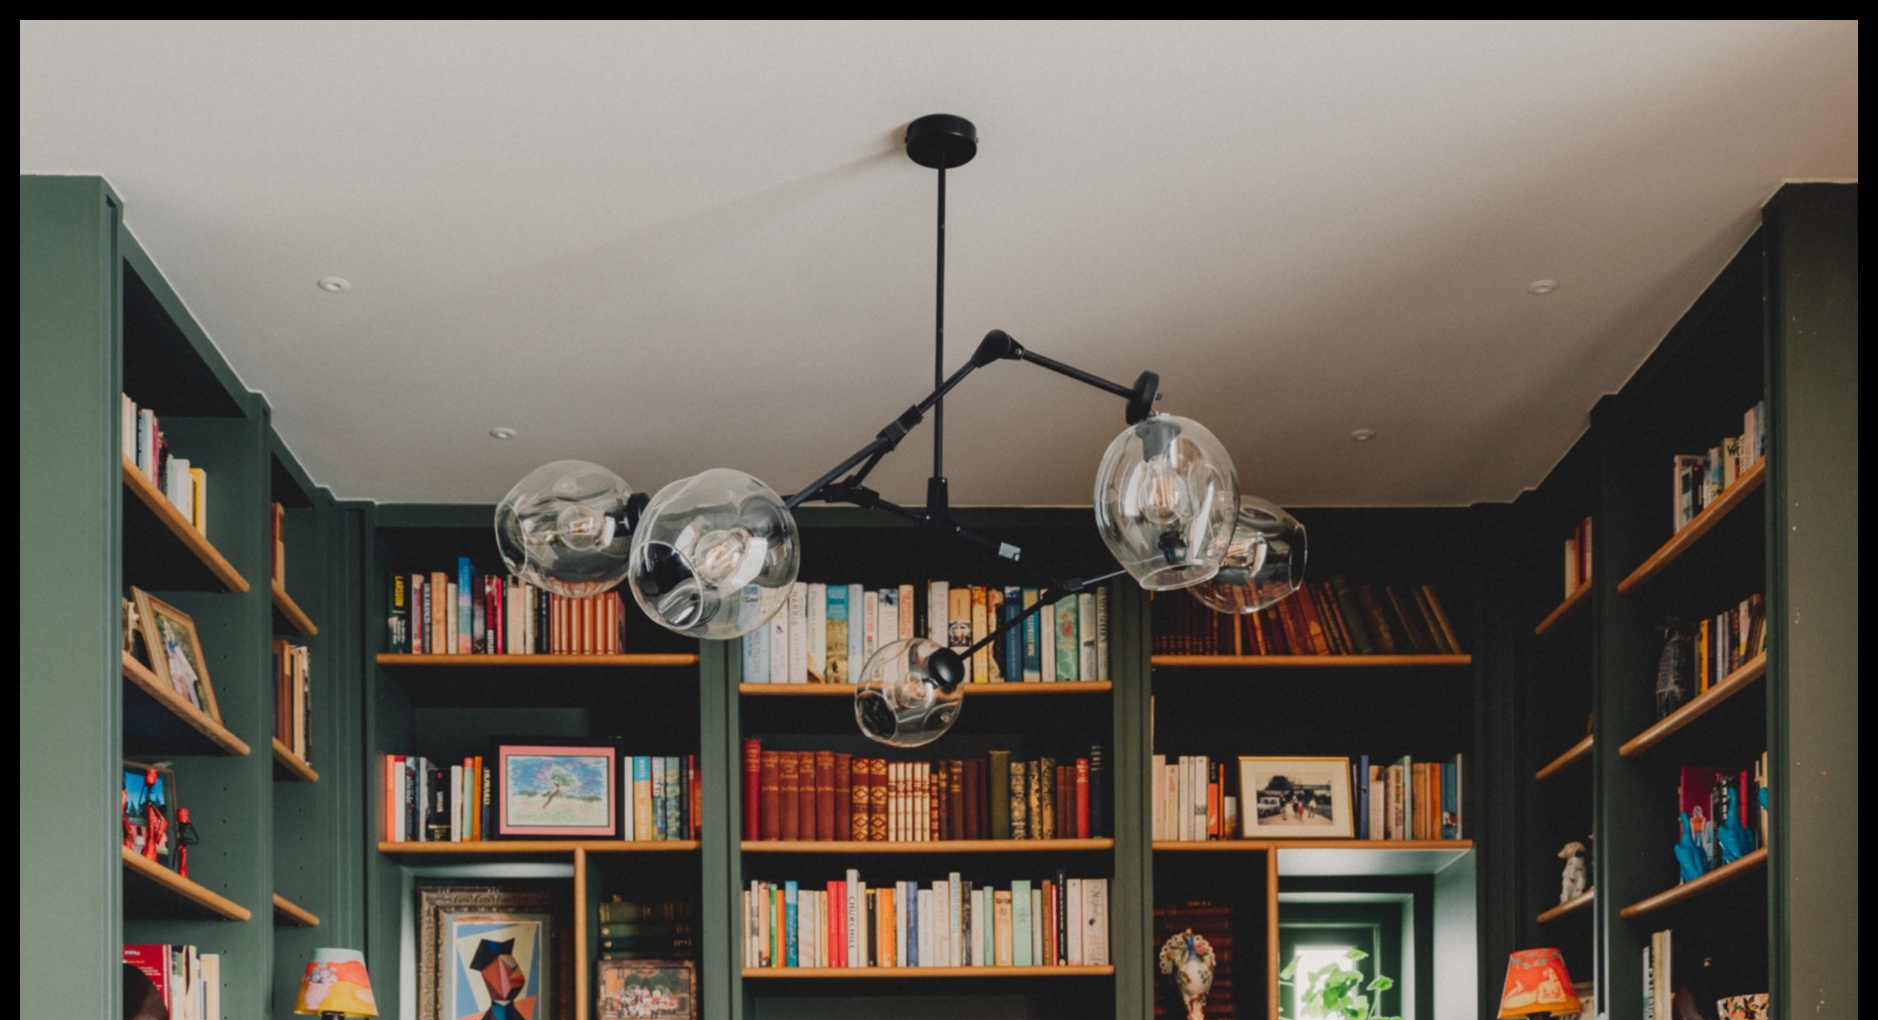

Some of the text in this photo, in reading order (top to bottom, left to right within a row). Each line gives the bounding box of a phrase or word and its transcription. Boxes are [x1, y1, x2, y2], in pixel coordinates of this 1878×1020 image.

[394, 575, 405, 607] LARSSON
[790, 591, 799, 626] HARRIS
[848, 896, 857, 949] CHURCHILL
